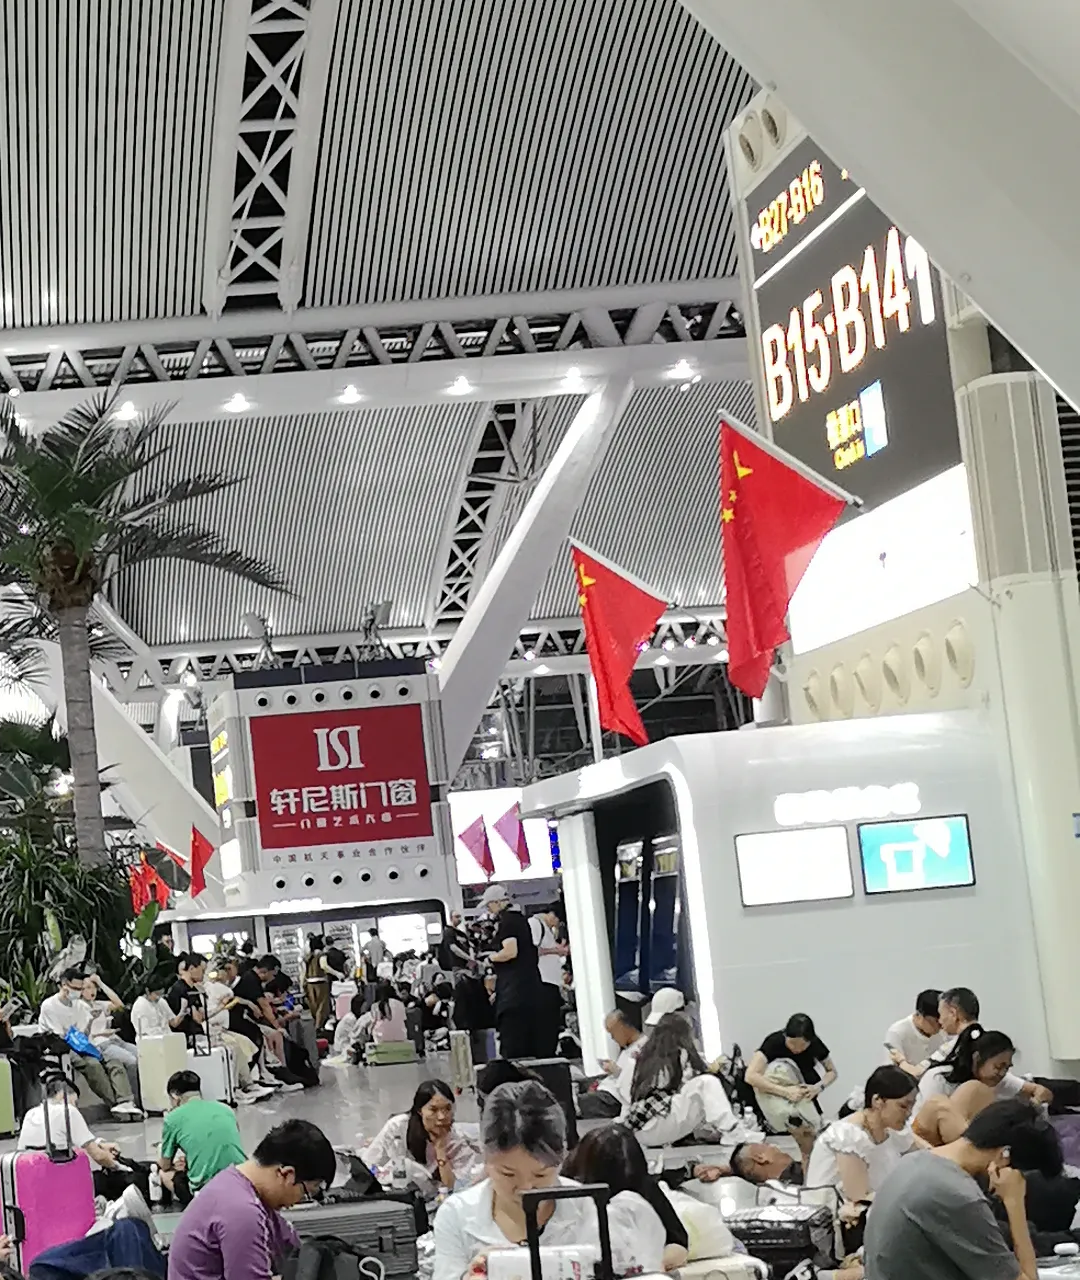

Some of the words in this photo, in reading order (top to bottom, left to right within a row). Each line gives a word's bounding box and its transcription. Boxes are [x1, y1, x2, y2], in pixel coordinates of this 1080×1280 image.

[270, 778, 417, 815] 轩尼斯门窗
